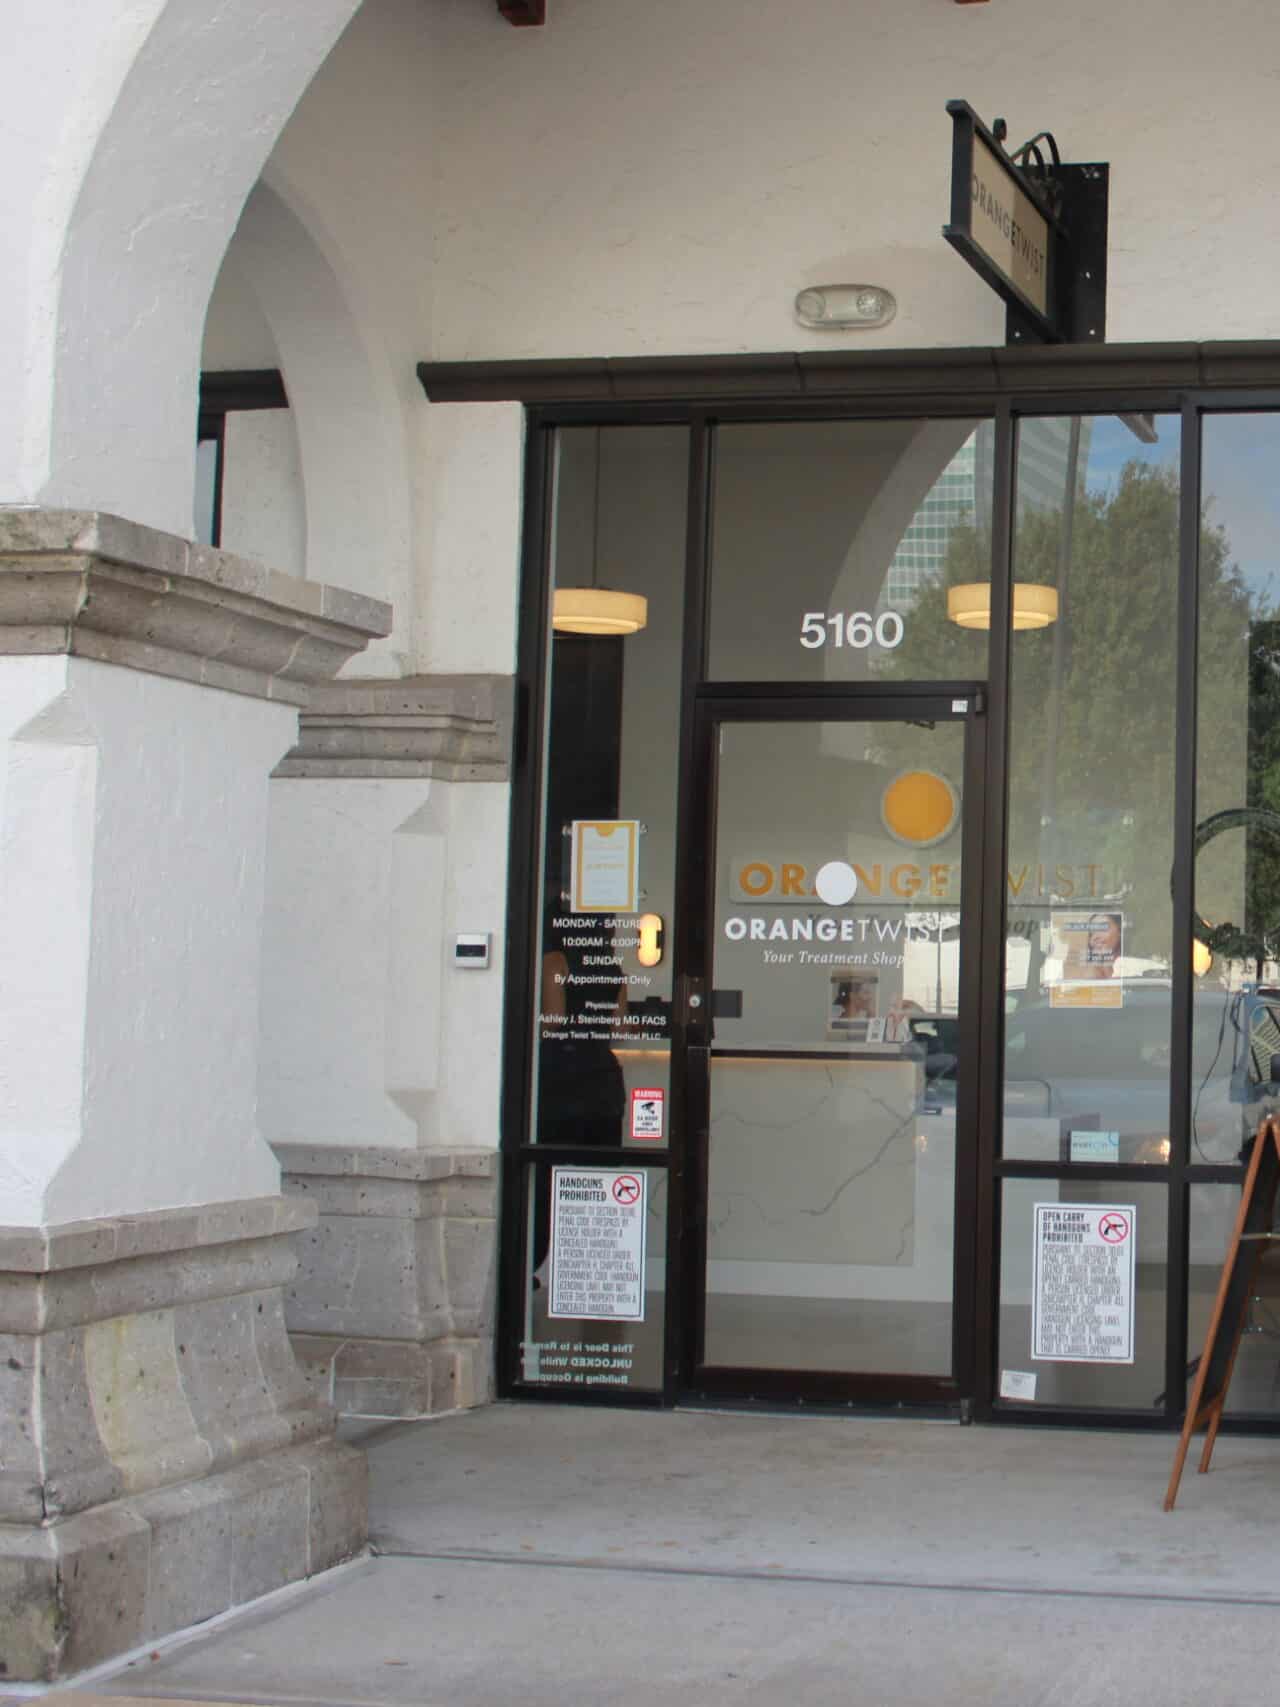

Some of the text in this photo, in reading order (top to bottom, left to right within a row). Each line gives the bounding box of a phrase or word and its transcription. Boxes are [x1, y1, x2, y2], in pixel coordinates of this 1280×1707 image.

[799, 611, 905, 649] 5160
[552, 917, 597, 929] MONDAY
[724, 916, 950, 942] ORANGETWIST
[562, 937, 604, 947] 10:00AM
[583, 955, 624, 966] SUNDAY
[762, 950, 905, 969] Your Treatment Shop
[554, 973, 652, 986] By Appointment Only
[539, 1013, 569, 1025] Ashley
[578, 1014, 621, 1027] Steinberg
[623, 1015, 640, 1025] MD
[641, 1016, 667, 1026] FACS
[559, 1176, 604, 1189] HANDGUNS
[559, 1190, 607, 1202] PROHIBITED
[1042, 1211, 1061, 1221] OPEN
[1042, 1232, 1083, 1243] PROHIBITED
